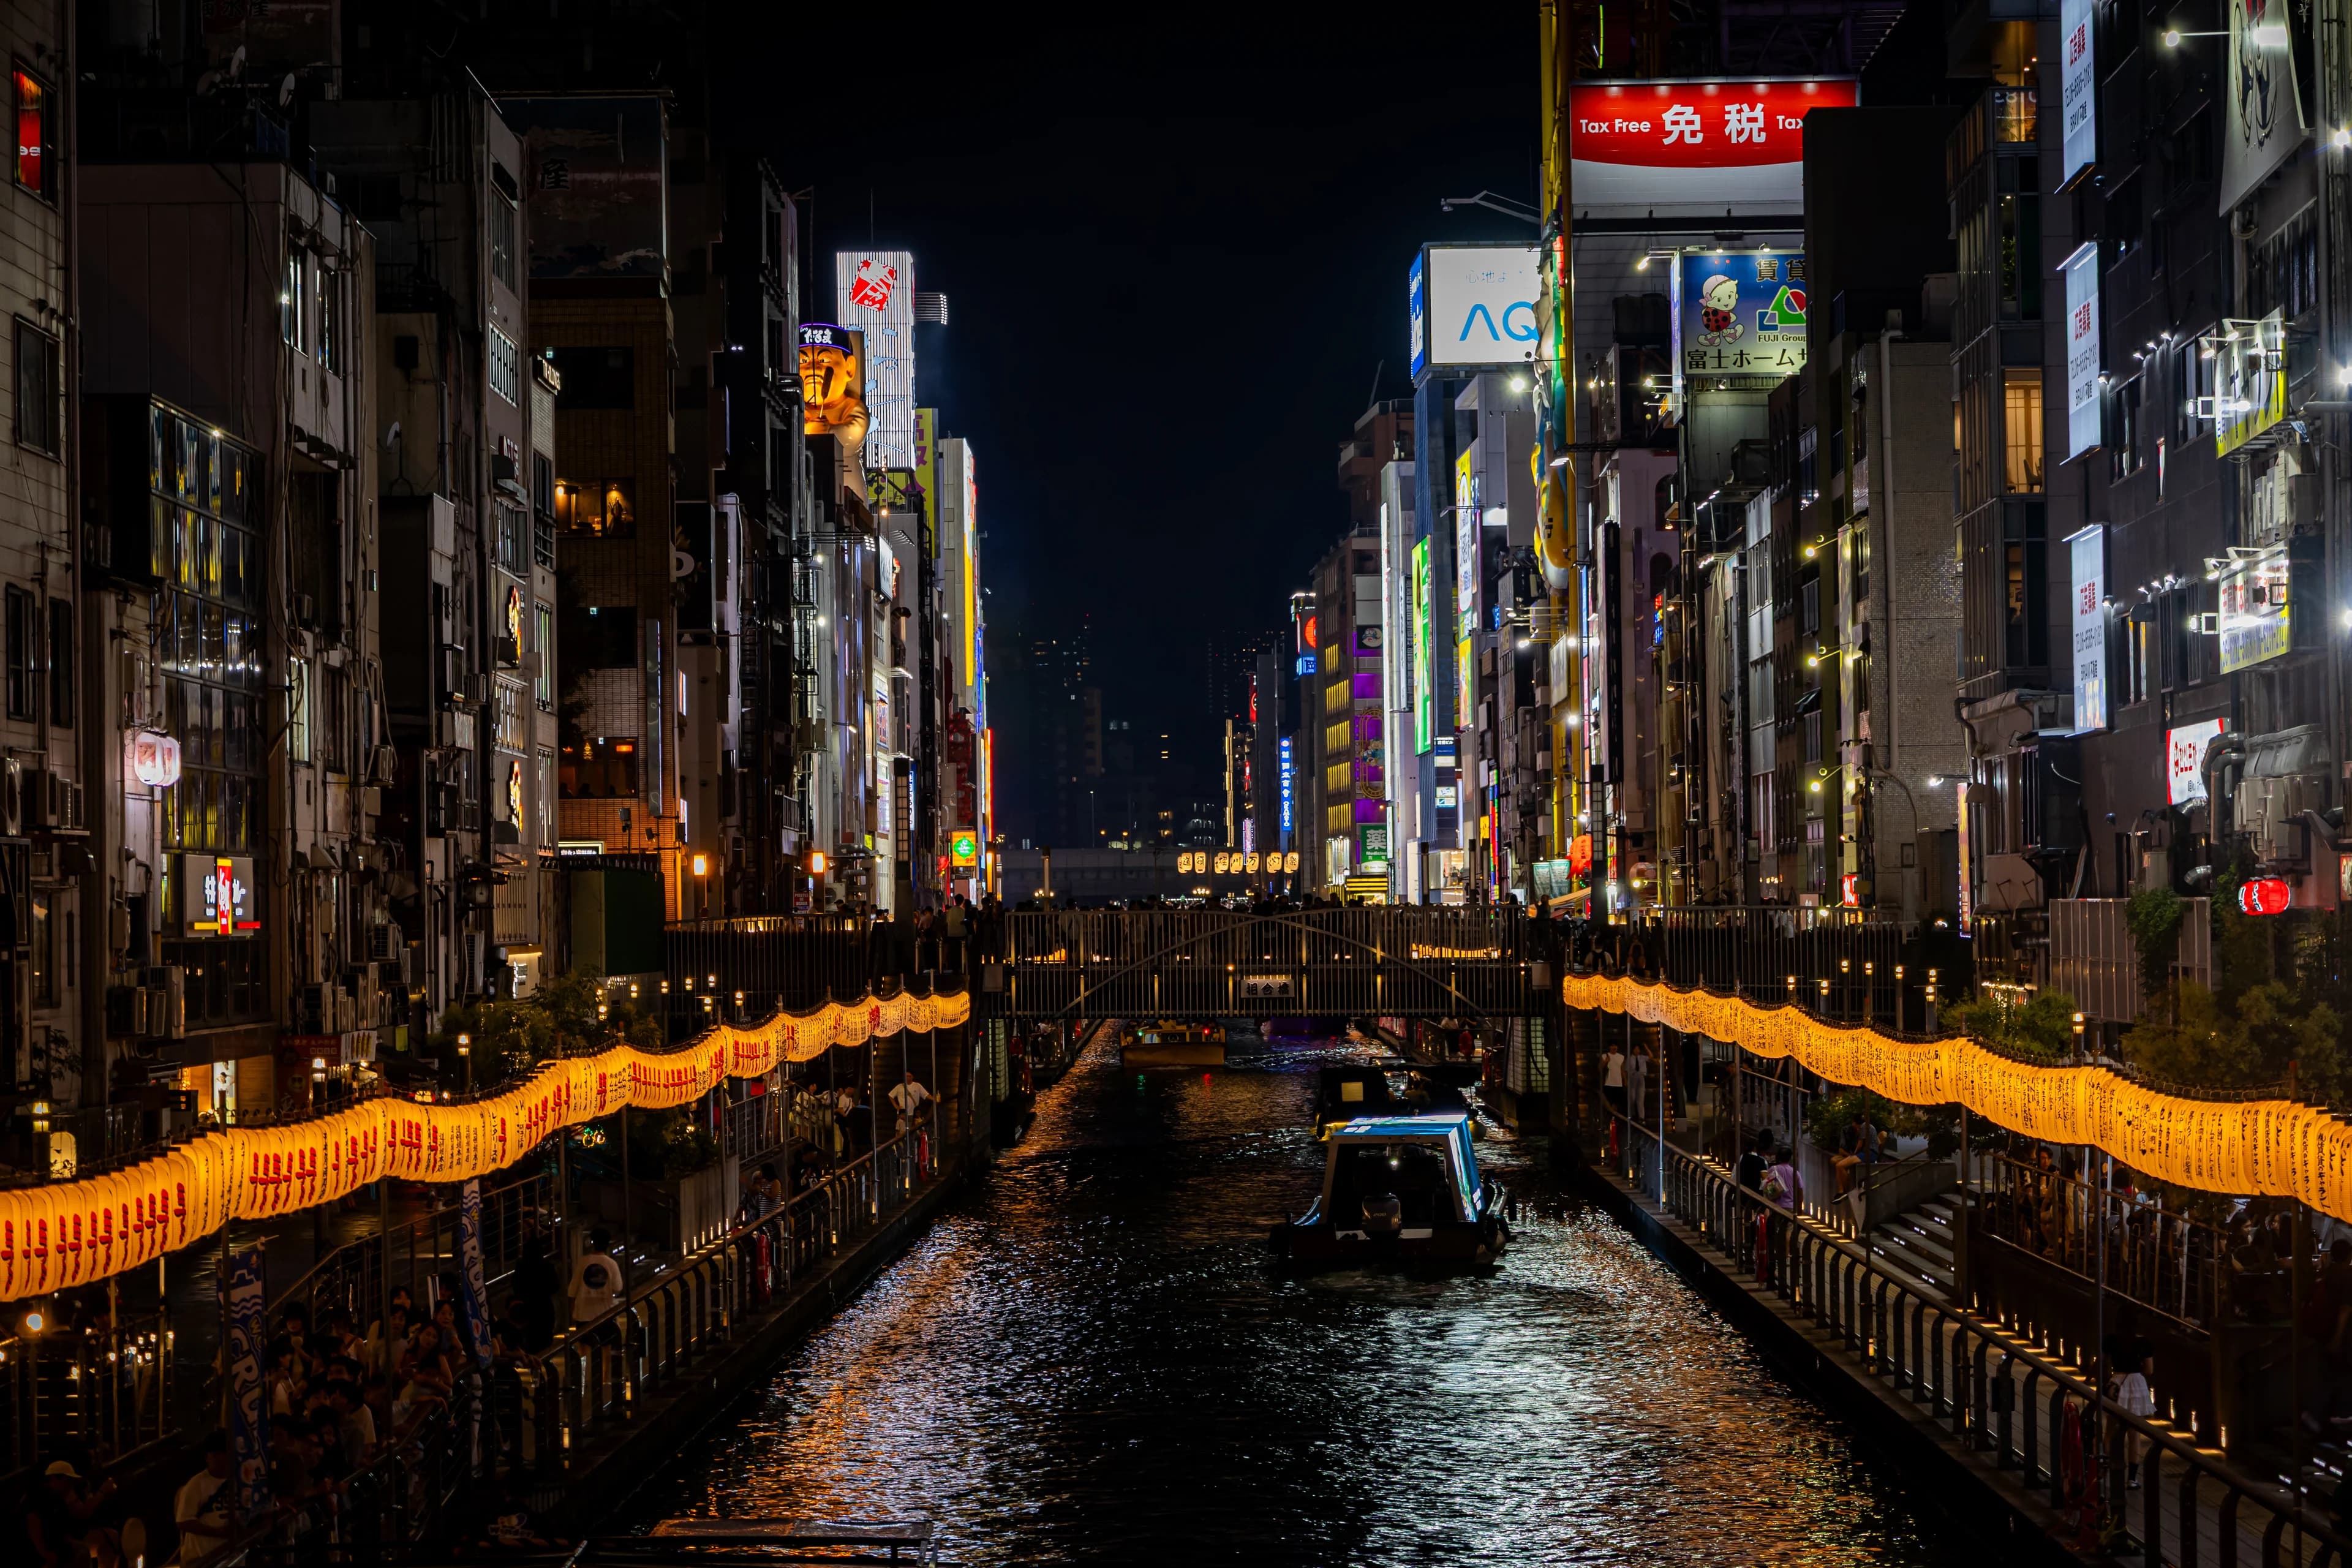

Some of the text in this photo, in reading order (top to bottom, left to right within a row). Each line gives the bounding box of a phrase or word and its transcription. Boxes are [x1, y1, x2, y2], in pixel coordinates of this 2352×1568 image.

[2070, 23, 2086, 68] 広告募集
[1580, 119, 1610, 134] Tax
[1615, 118, 1651, 133] Free
[1776, 115, 1803, 130] Tax
[1755, 258, 1806, 282] 賃貸
[2075, 301, 2091, 342] 広告募集
[2080, 581, 2096, 616] 広告募集
[1366, 829, 1387, 850] 薬
[1246, 981, 1289, 995] 相合橋
